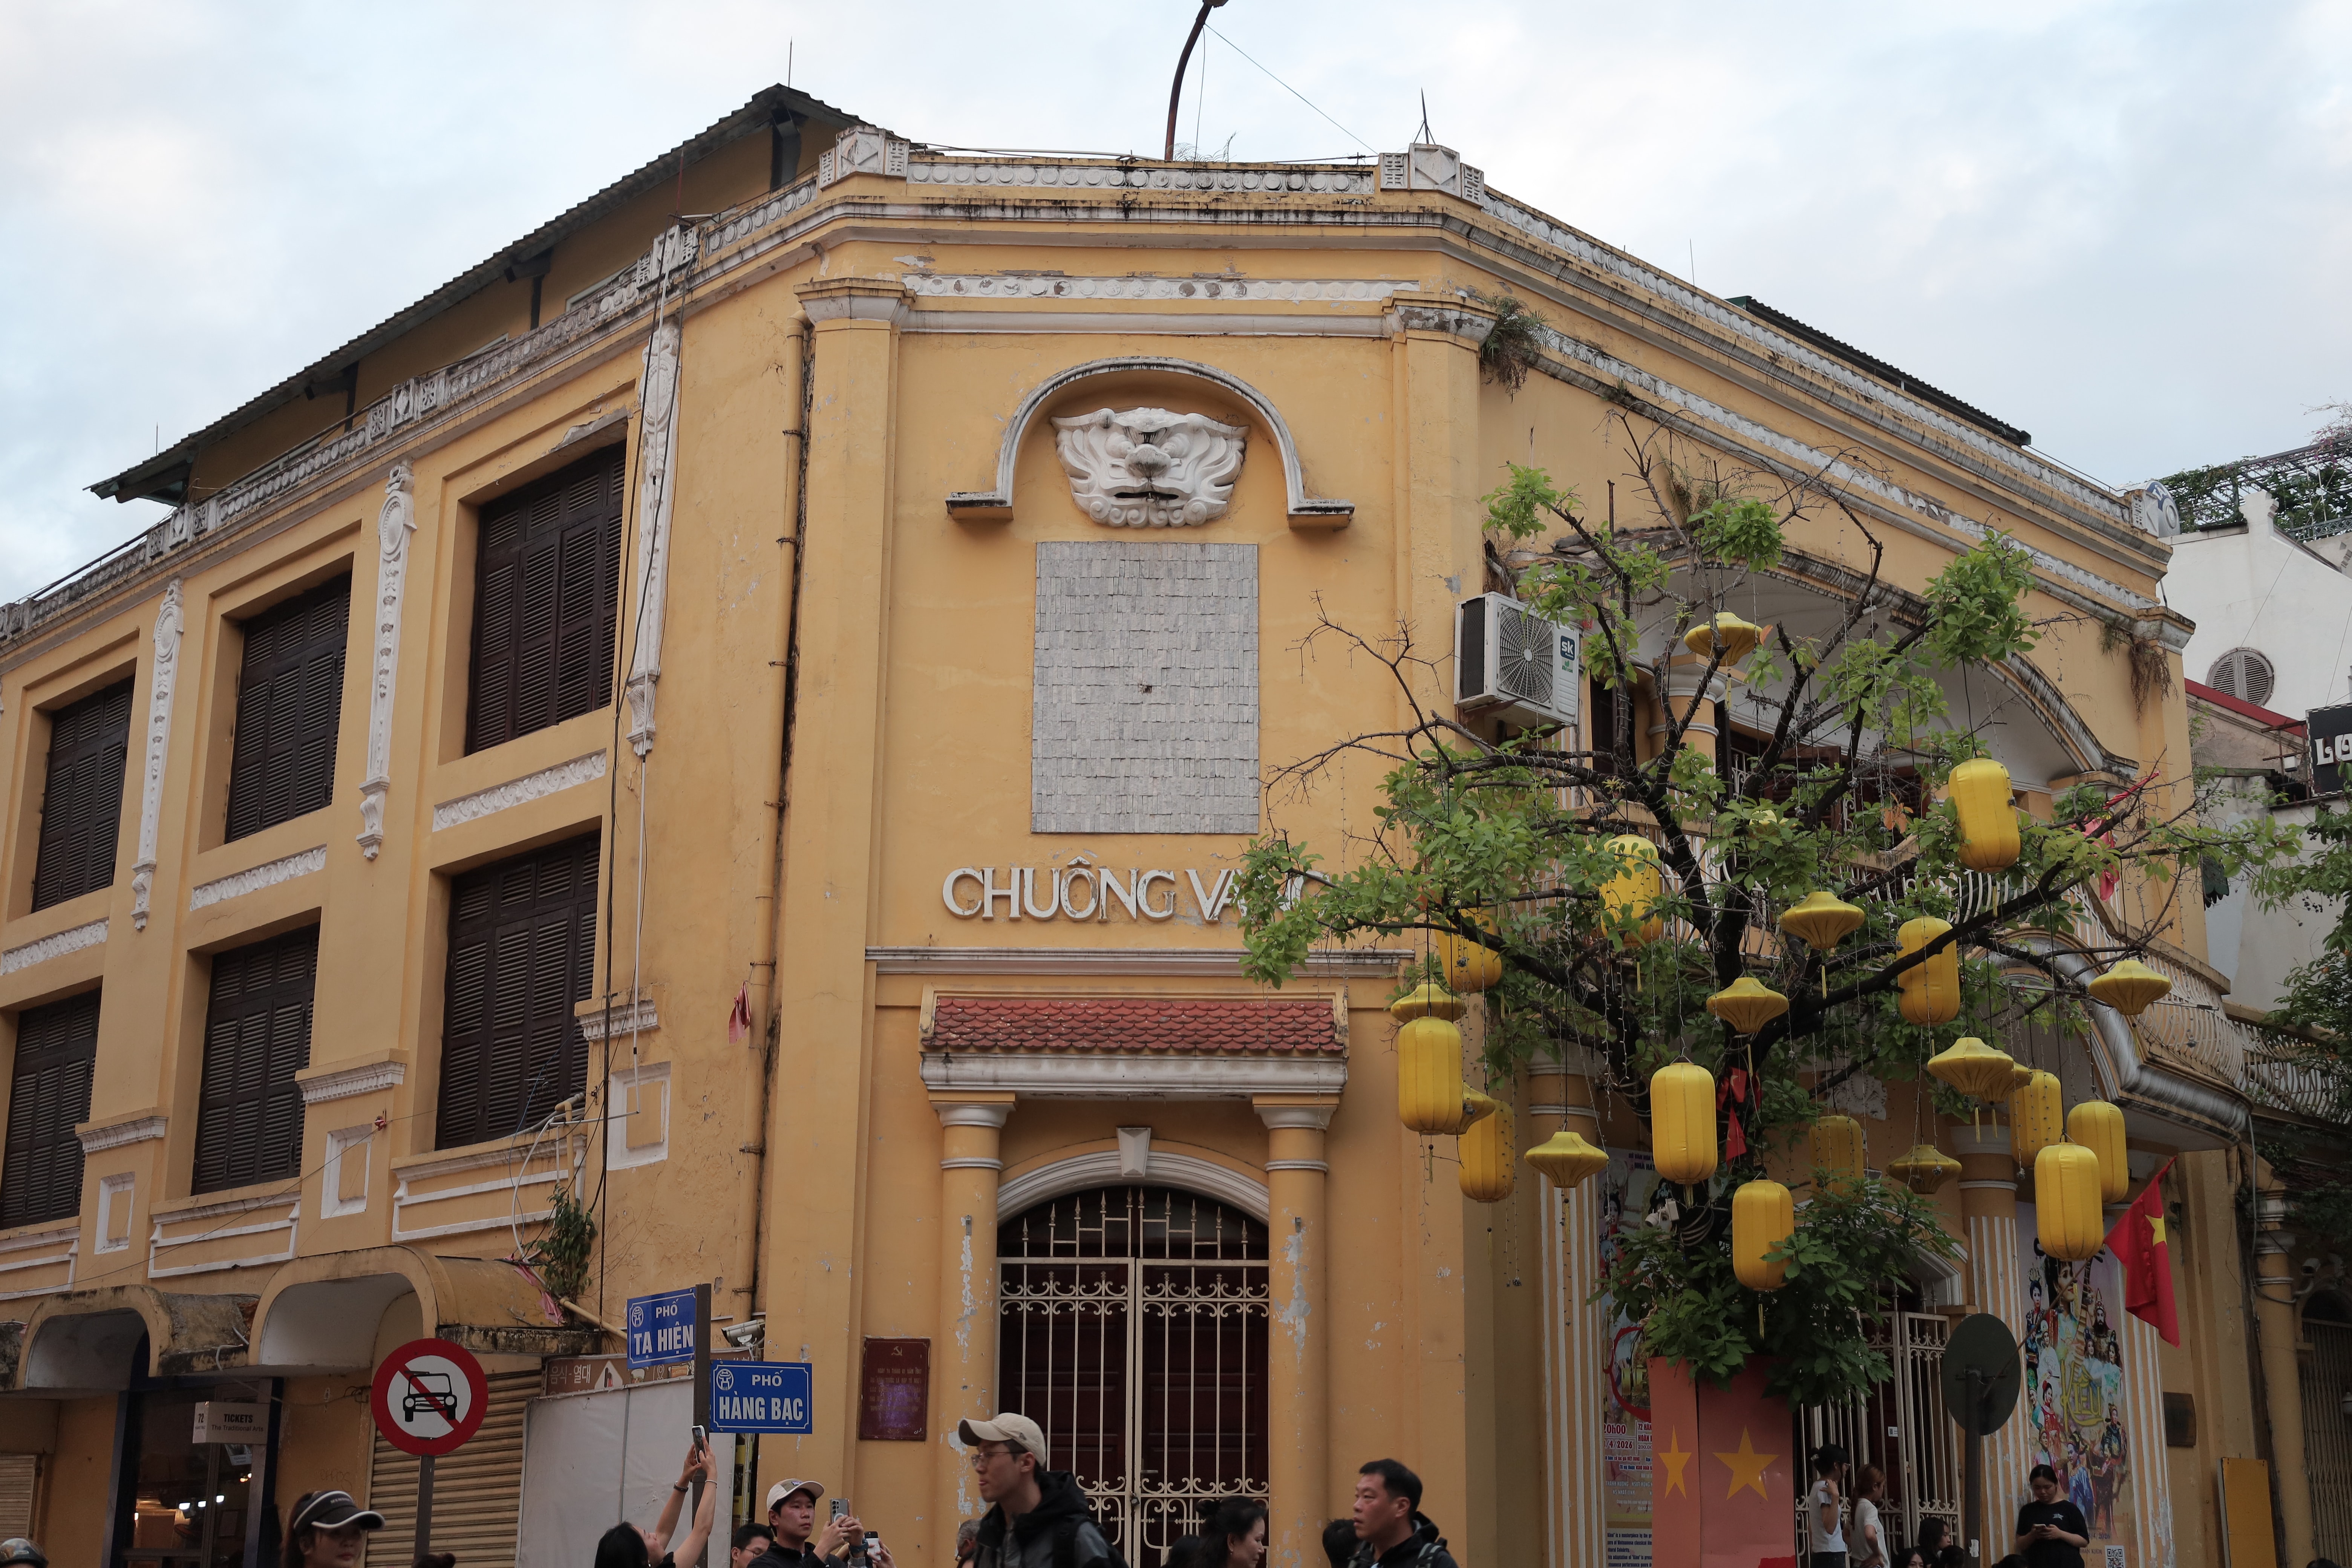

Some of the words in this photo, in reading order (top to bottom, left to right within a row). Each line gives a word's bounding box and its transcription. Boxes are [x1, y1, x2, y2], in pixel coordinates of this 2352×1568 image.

[942, 856, 1176, 922] CHUÔNG
[656, 1298, 678, 1318] PHỐ
[634, 1331, 652, 1358] TẠ
[658, 1321, 693, 1354] HIỆN
[550, 1365, 567, 1384] 음식
[574, 1364, 591, 1384] 열대
[752, 1370, 783, 1386] PHỐ
[720, 1390, 765, 1420] HÀNG
[771, 1398, 803, 1425] BẠC
[198, 1413, 204, 1423] 72
[224, 1414, 253, 1423] TICKETS
